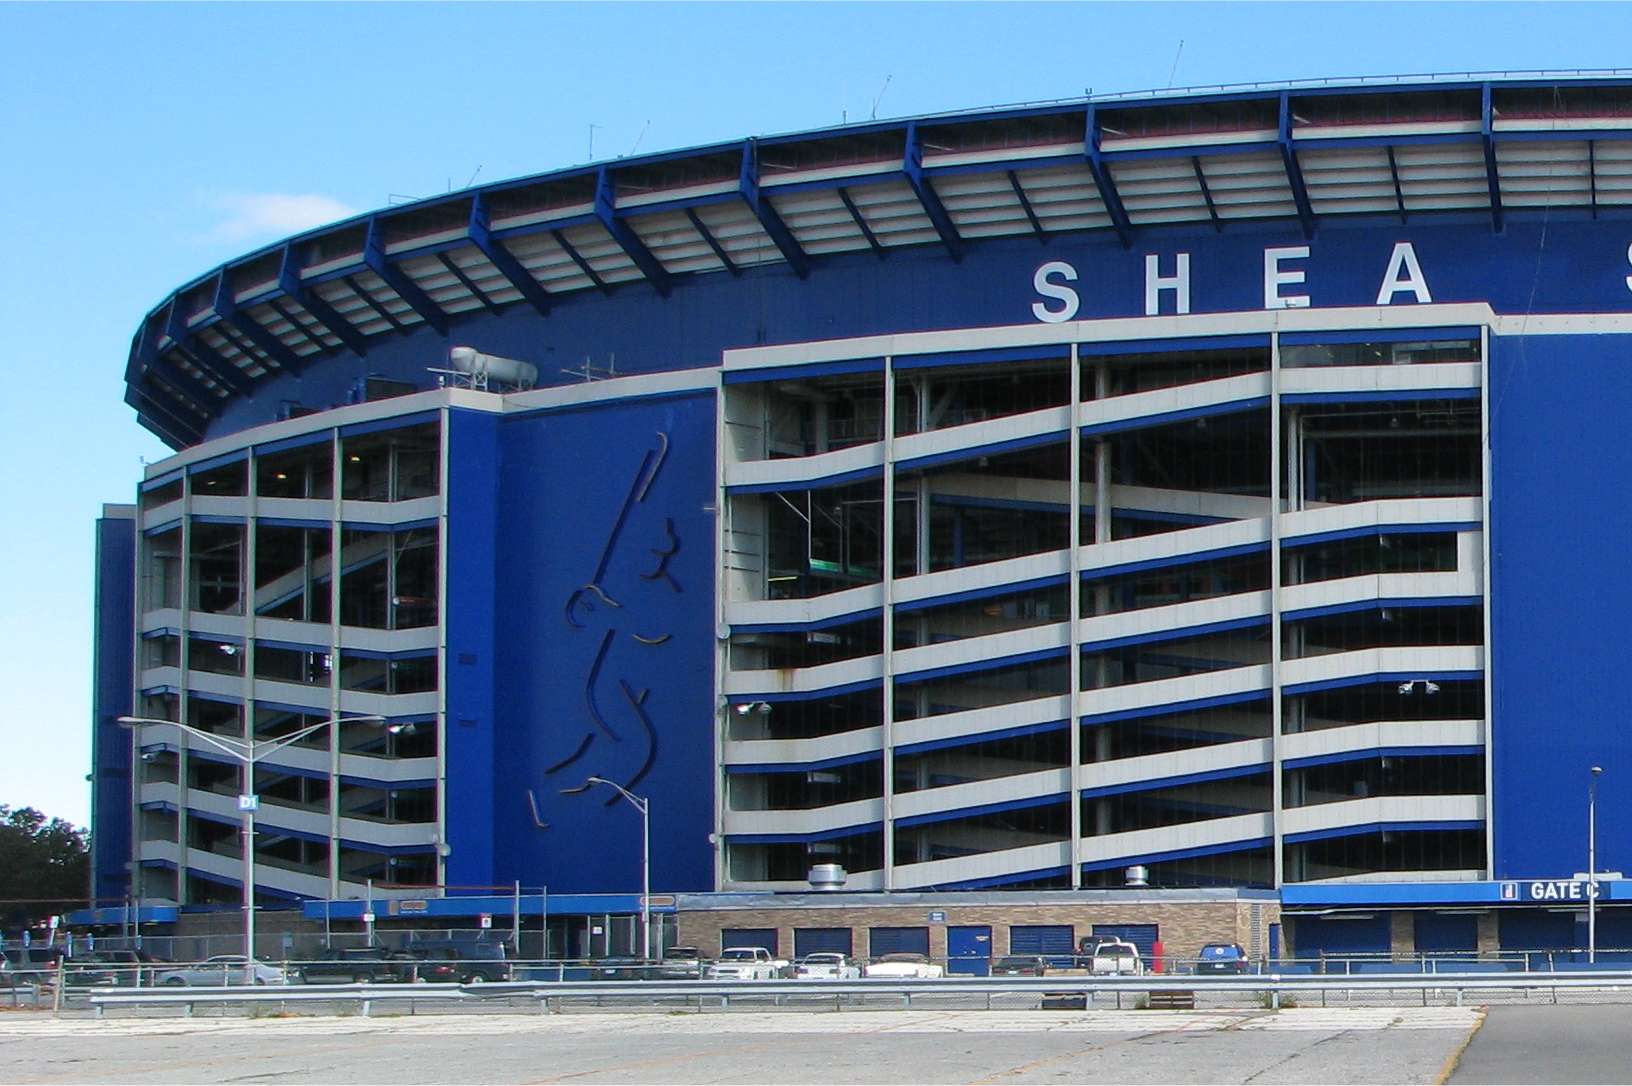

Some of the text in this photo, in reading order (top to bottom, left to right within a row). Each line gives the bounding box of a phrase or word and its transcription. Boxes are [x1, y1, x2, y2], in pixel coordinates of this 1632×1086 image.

[1032, 242, 1432, 323] SHEA
[240, 796, 257, 809] D1
[1531, 881, 1599, 900] GATE C
